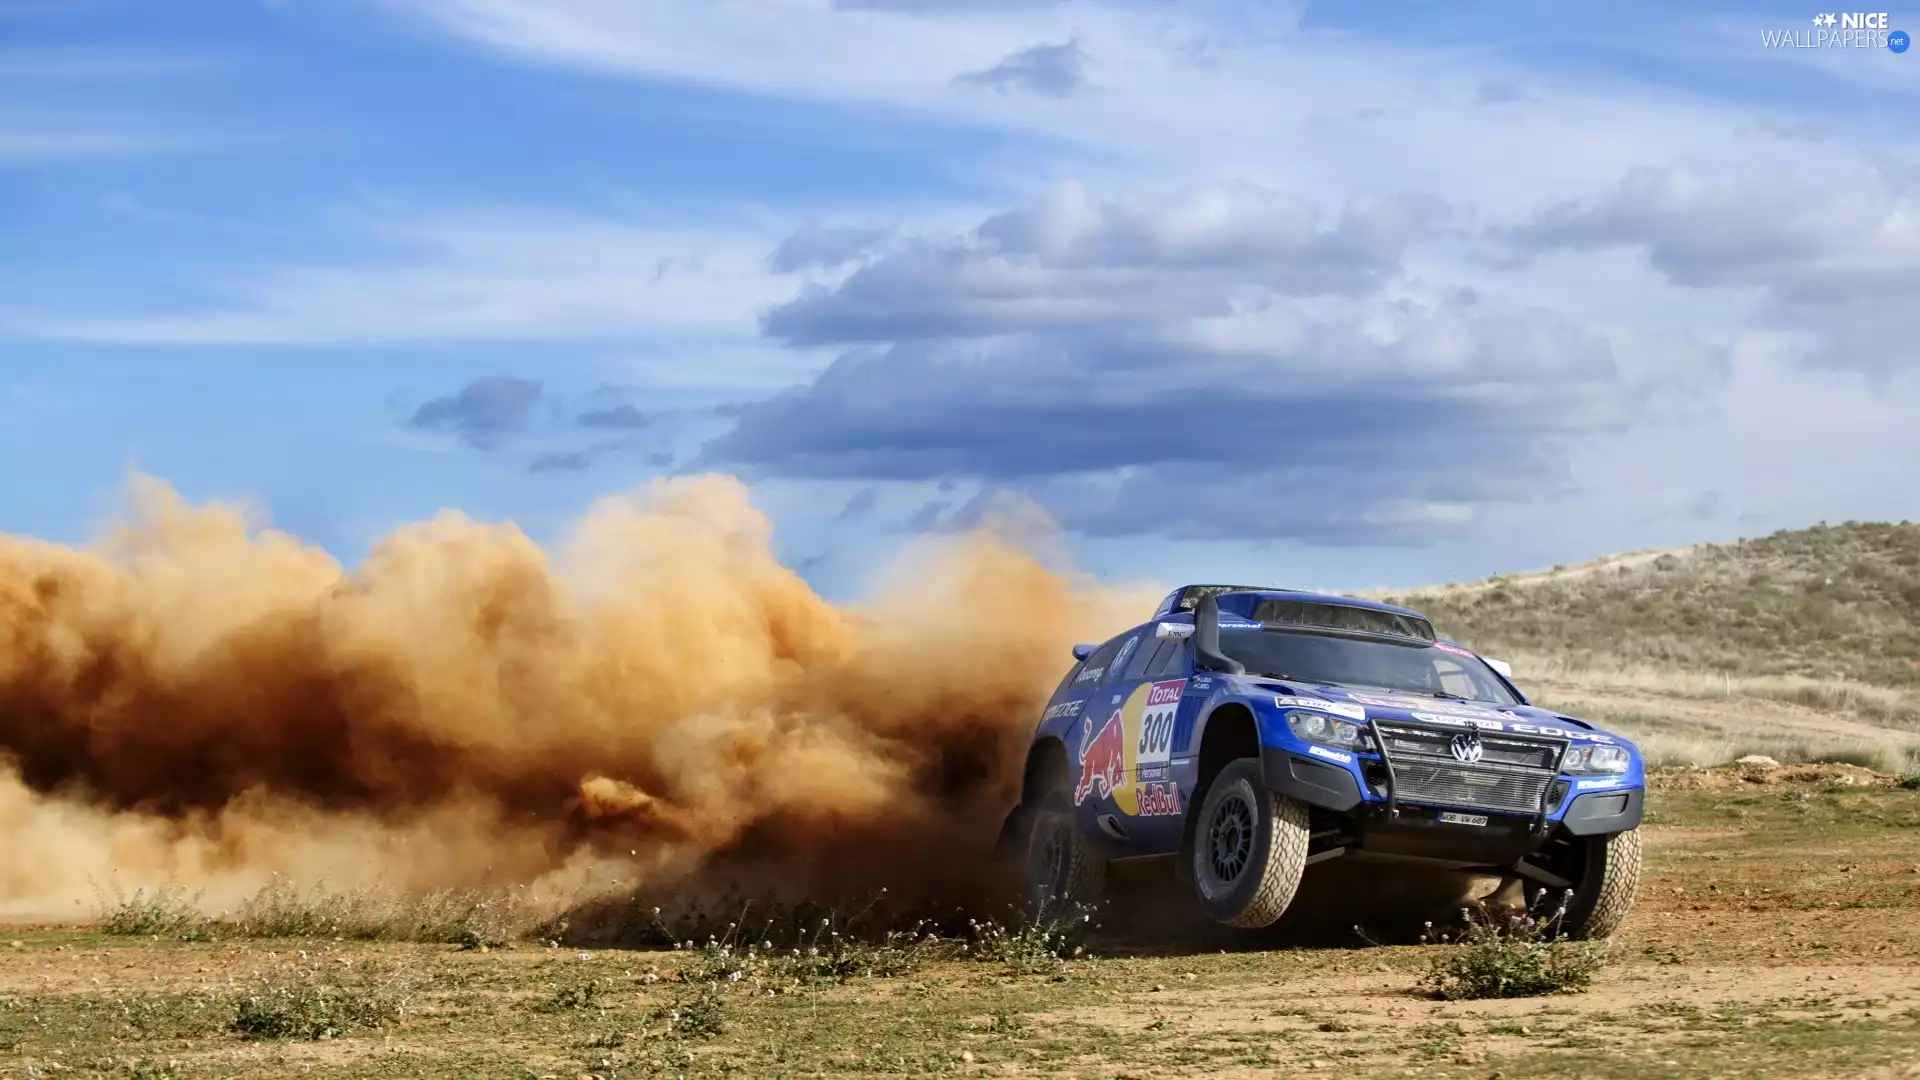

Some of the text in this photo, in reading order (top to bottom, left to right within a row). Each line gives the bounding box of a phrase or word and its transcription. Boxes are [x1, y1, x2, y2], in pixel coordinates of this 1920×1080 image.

[1150, 685, 1181, 704] TOTAL
[1139, 711, 1174, 755] 300
[1508, 722, 1616, 745] EDGE
